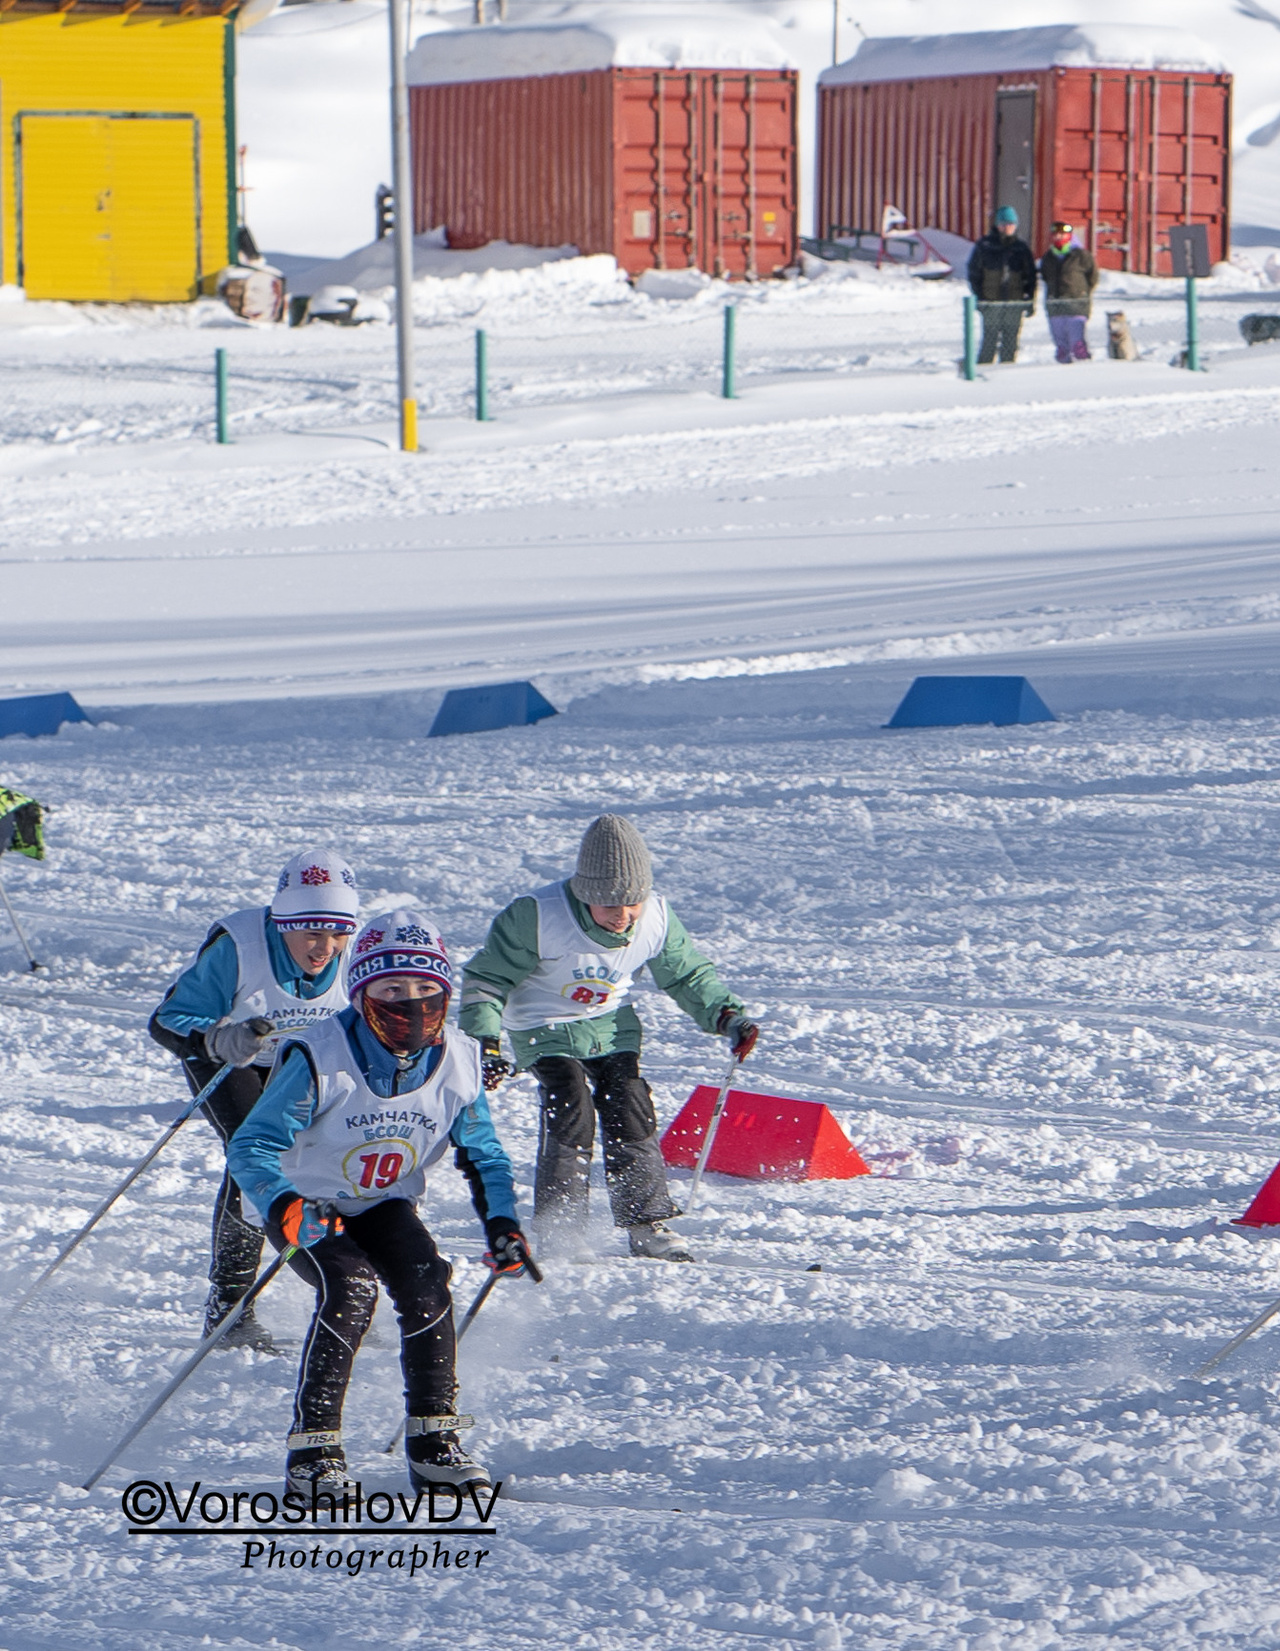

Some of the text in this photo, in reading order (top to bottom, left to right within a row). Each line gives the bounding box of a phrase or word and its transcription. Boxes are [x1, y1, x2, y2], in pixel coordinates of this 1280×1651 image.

[345, 1111, 438, 1134] КАМЧАТКА
[363, 1125, 415, 1141] БСОШ
[359, 1153, 404, 1189] 19
[437, 1418, 461, 1428] TISA
[306, 1434, 337, 1444] TISA
